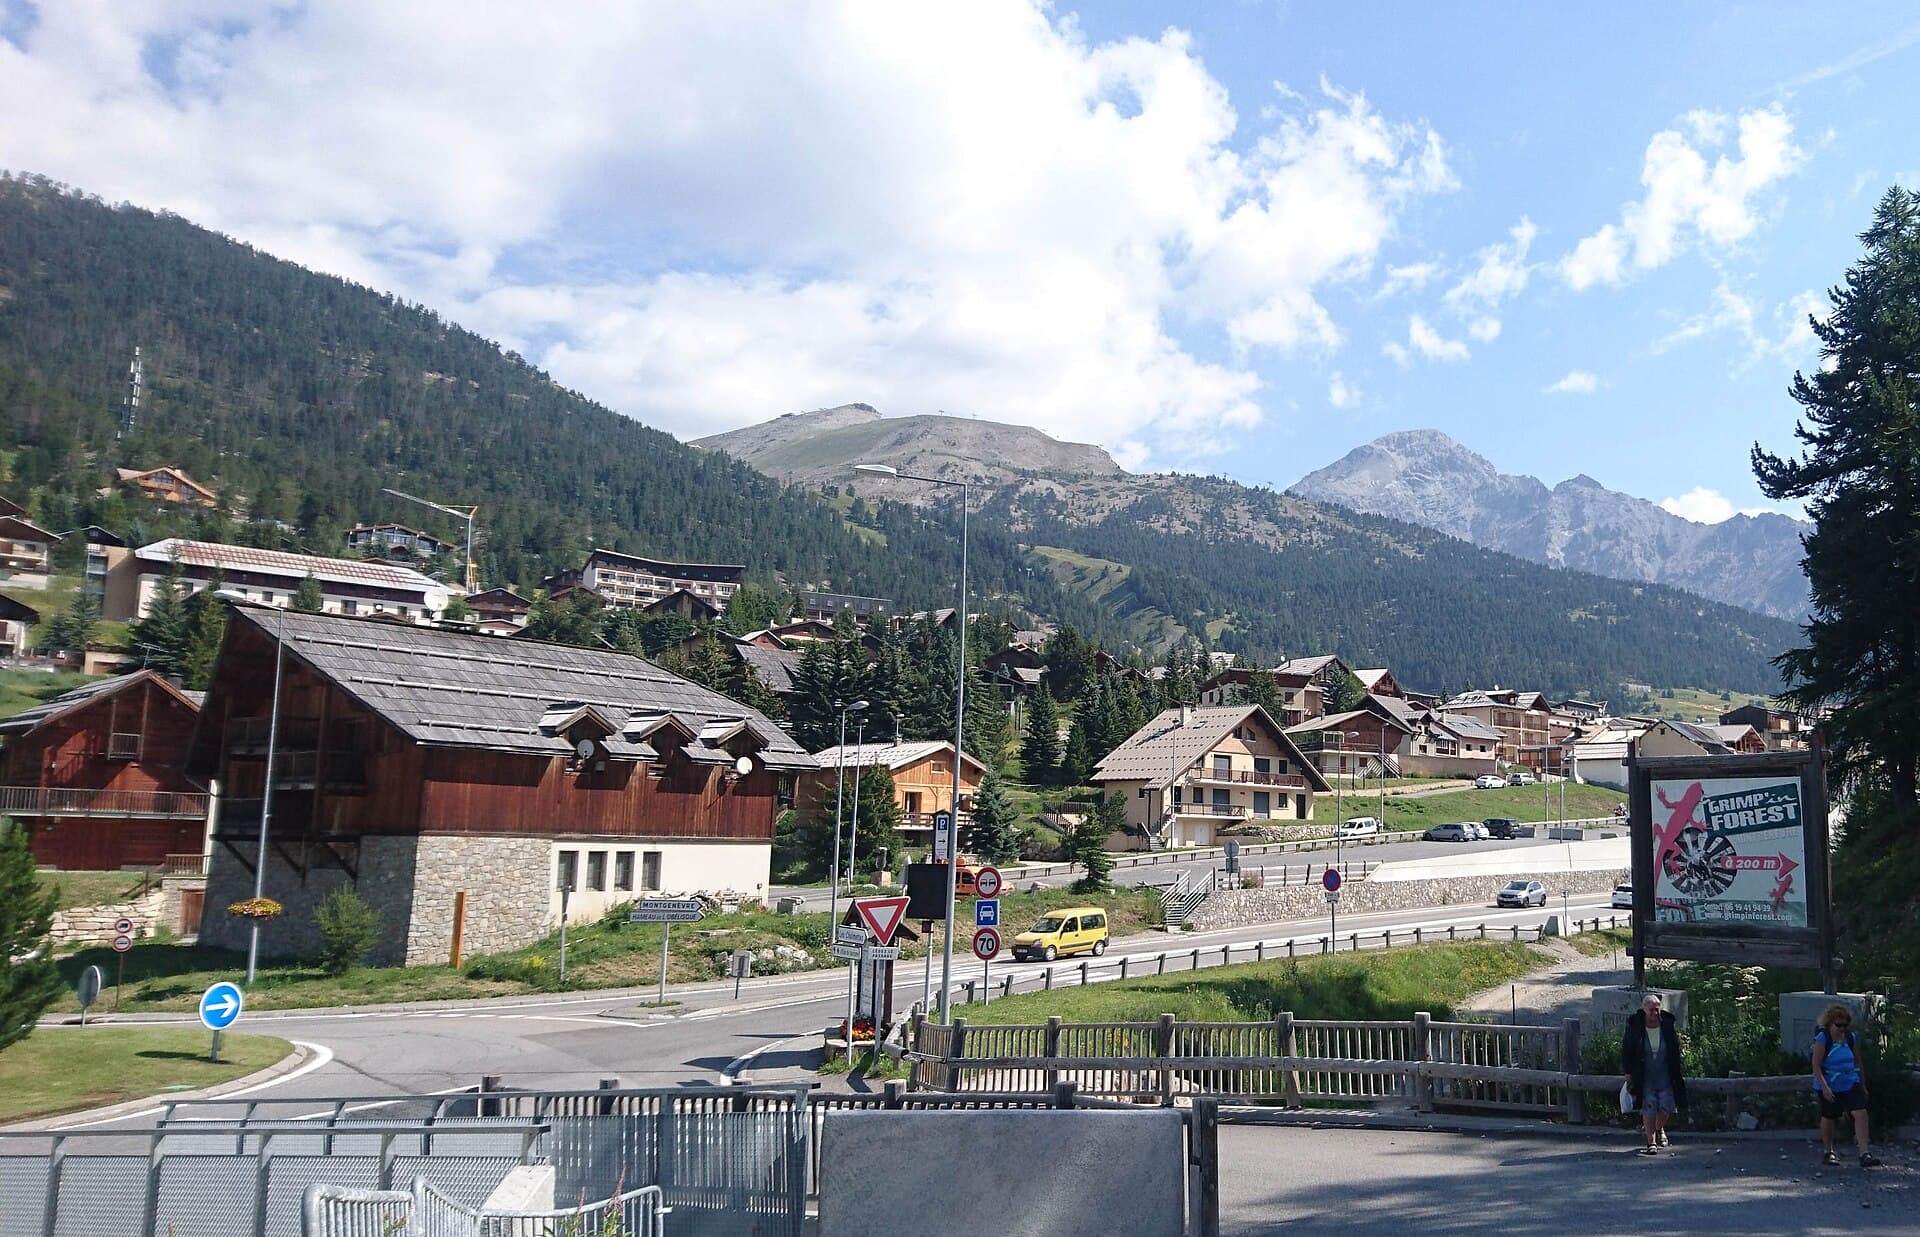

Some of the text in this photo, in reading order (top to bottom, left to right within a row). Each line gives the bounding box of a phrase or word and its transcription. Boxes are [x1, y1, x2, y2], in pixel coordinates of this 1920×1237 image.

[1711, 802, 1798, 831] FOREST
[940, 819, 946, 829] P
[1725, 856, 1733, 868] à
[1736, 859, 1760, 869] 200
[979, 938, 995, 952] 70
